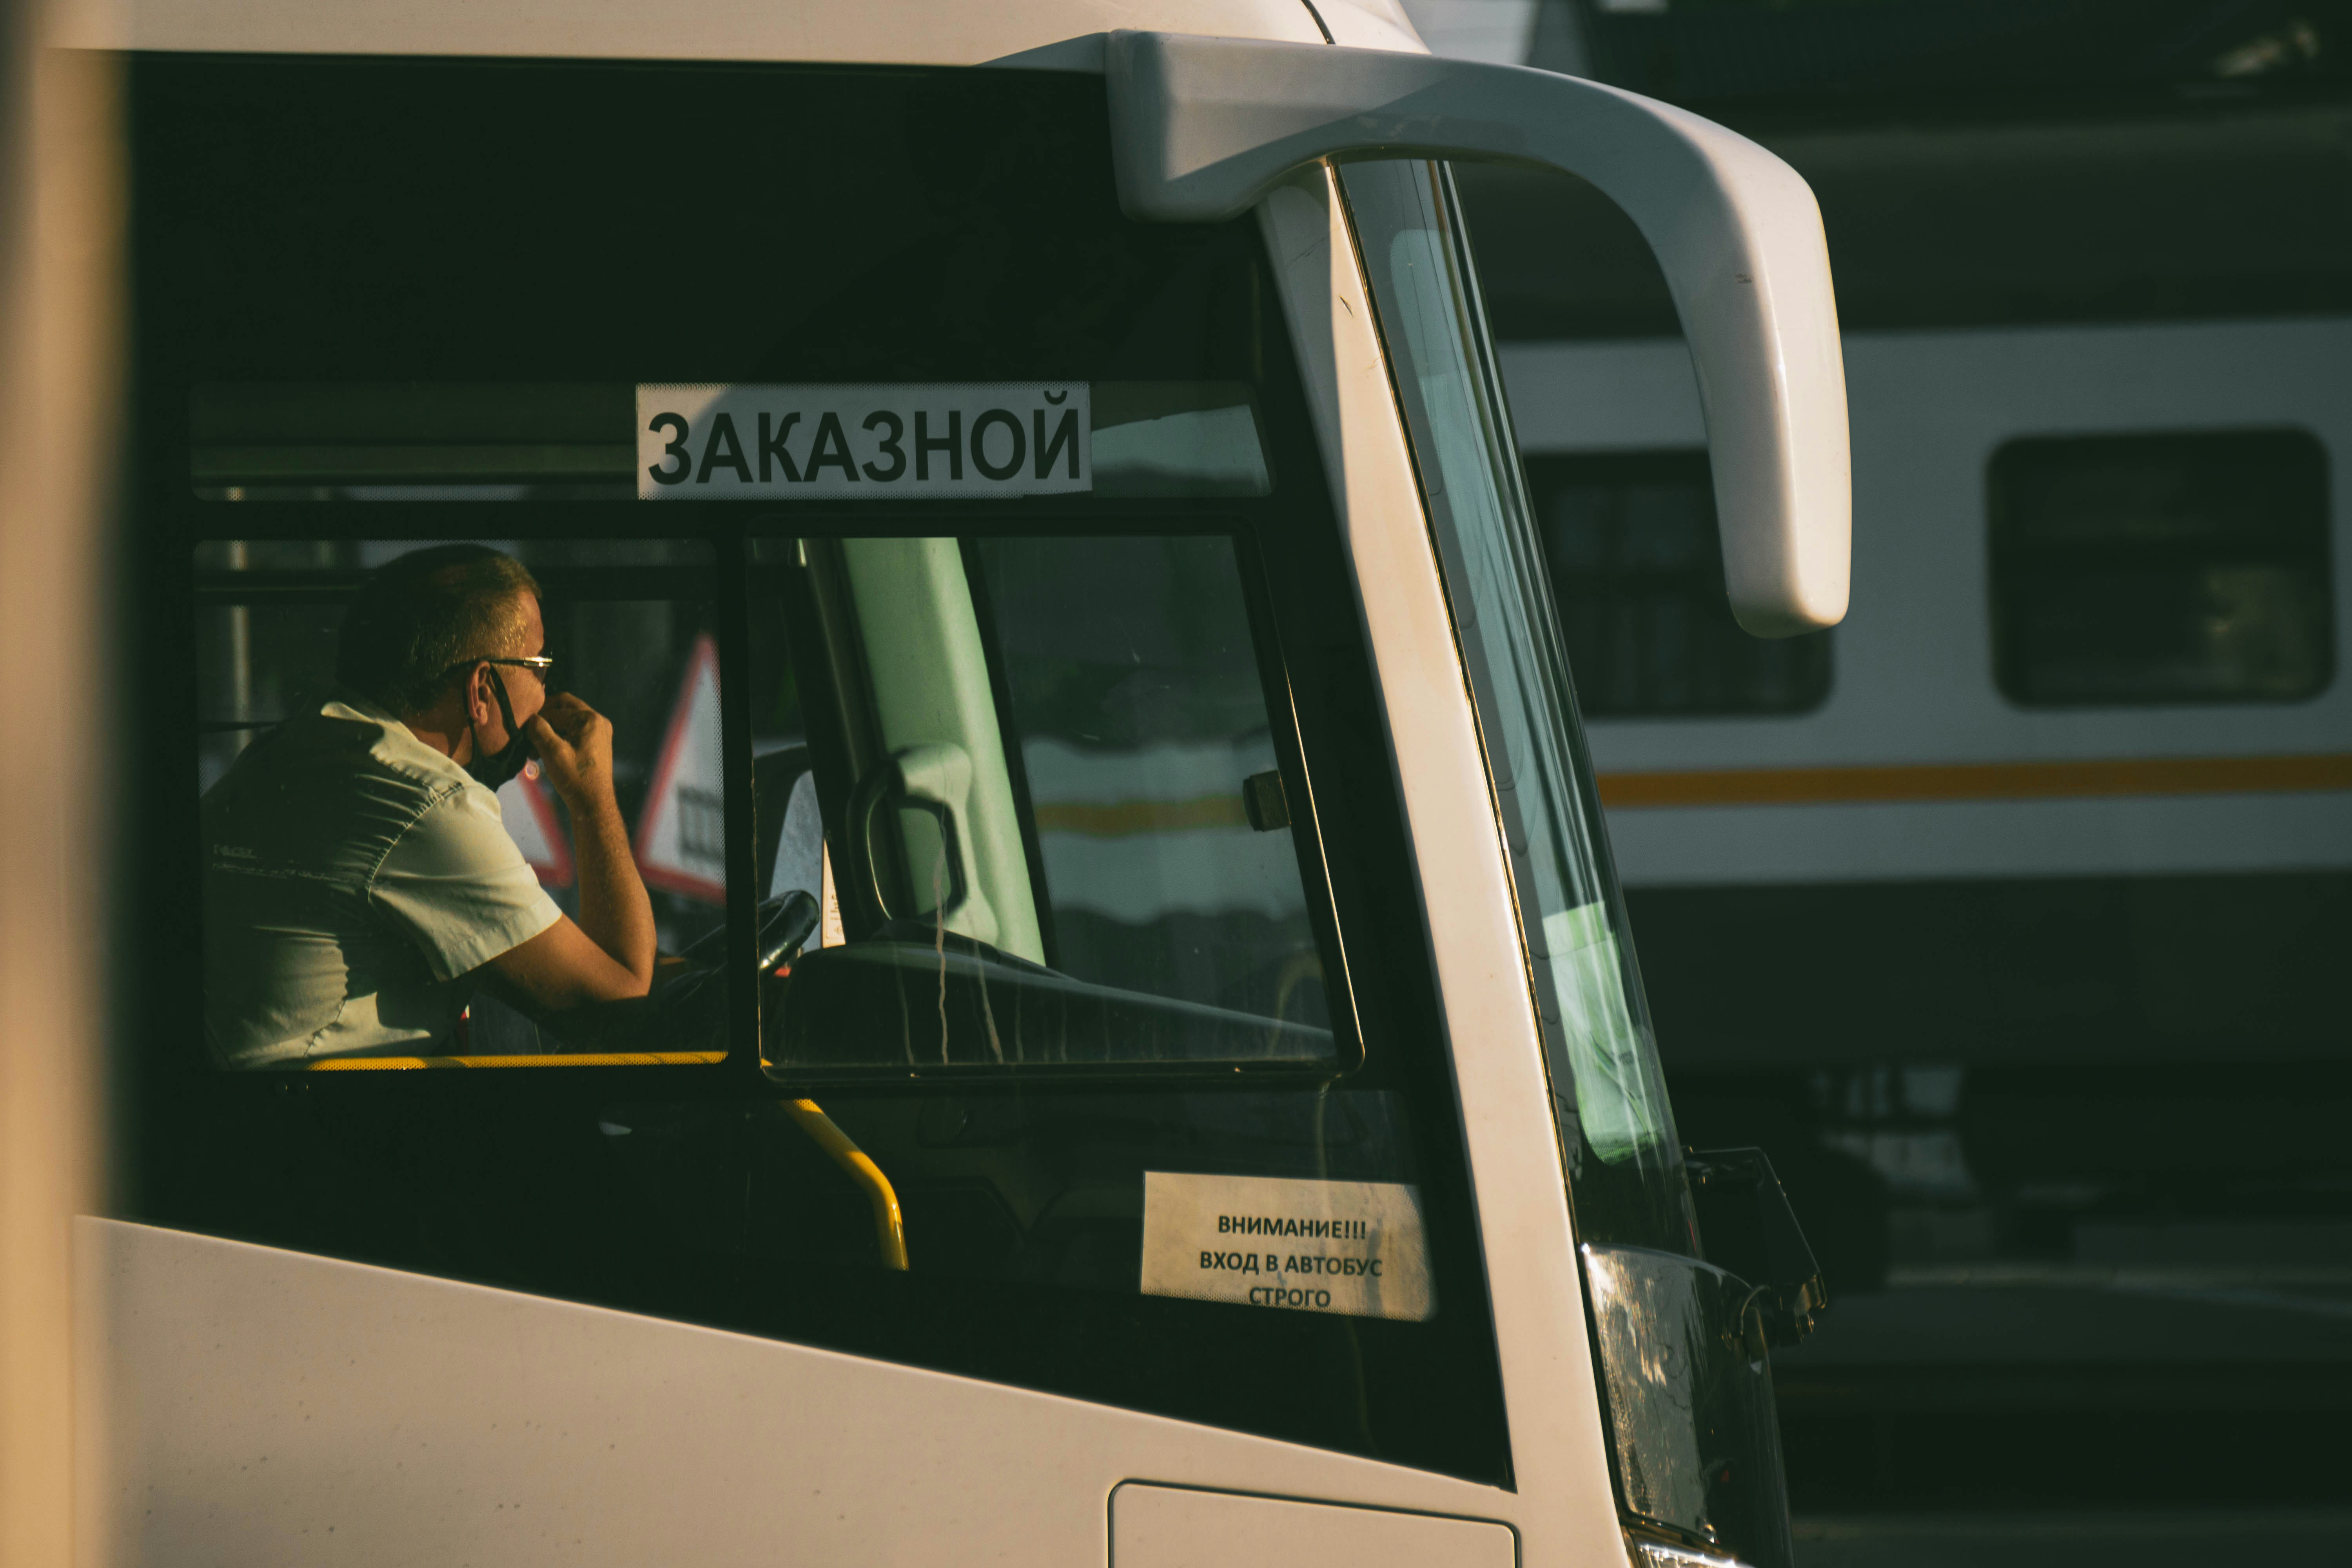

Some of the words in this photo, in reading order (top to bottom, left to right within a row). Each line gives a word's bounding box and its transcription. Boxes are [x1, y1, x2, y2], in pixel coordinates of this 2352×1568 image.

[648, 390, 1081, 485] ЗАКАЗНОЙ
[1218, 1215, 1367, 1240] ВНИМАНИЕ!!!
[1200, 1251, 1259, 1275] ВХОД
[1266, 1254, 1279, 1272] В
[1285, 1256, 1382, 1276] АВТОБУС
[1249, 1286, 1331, 1308] СТРОГО
